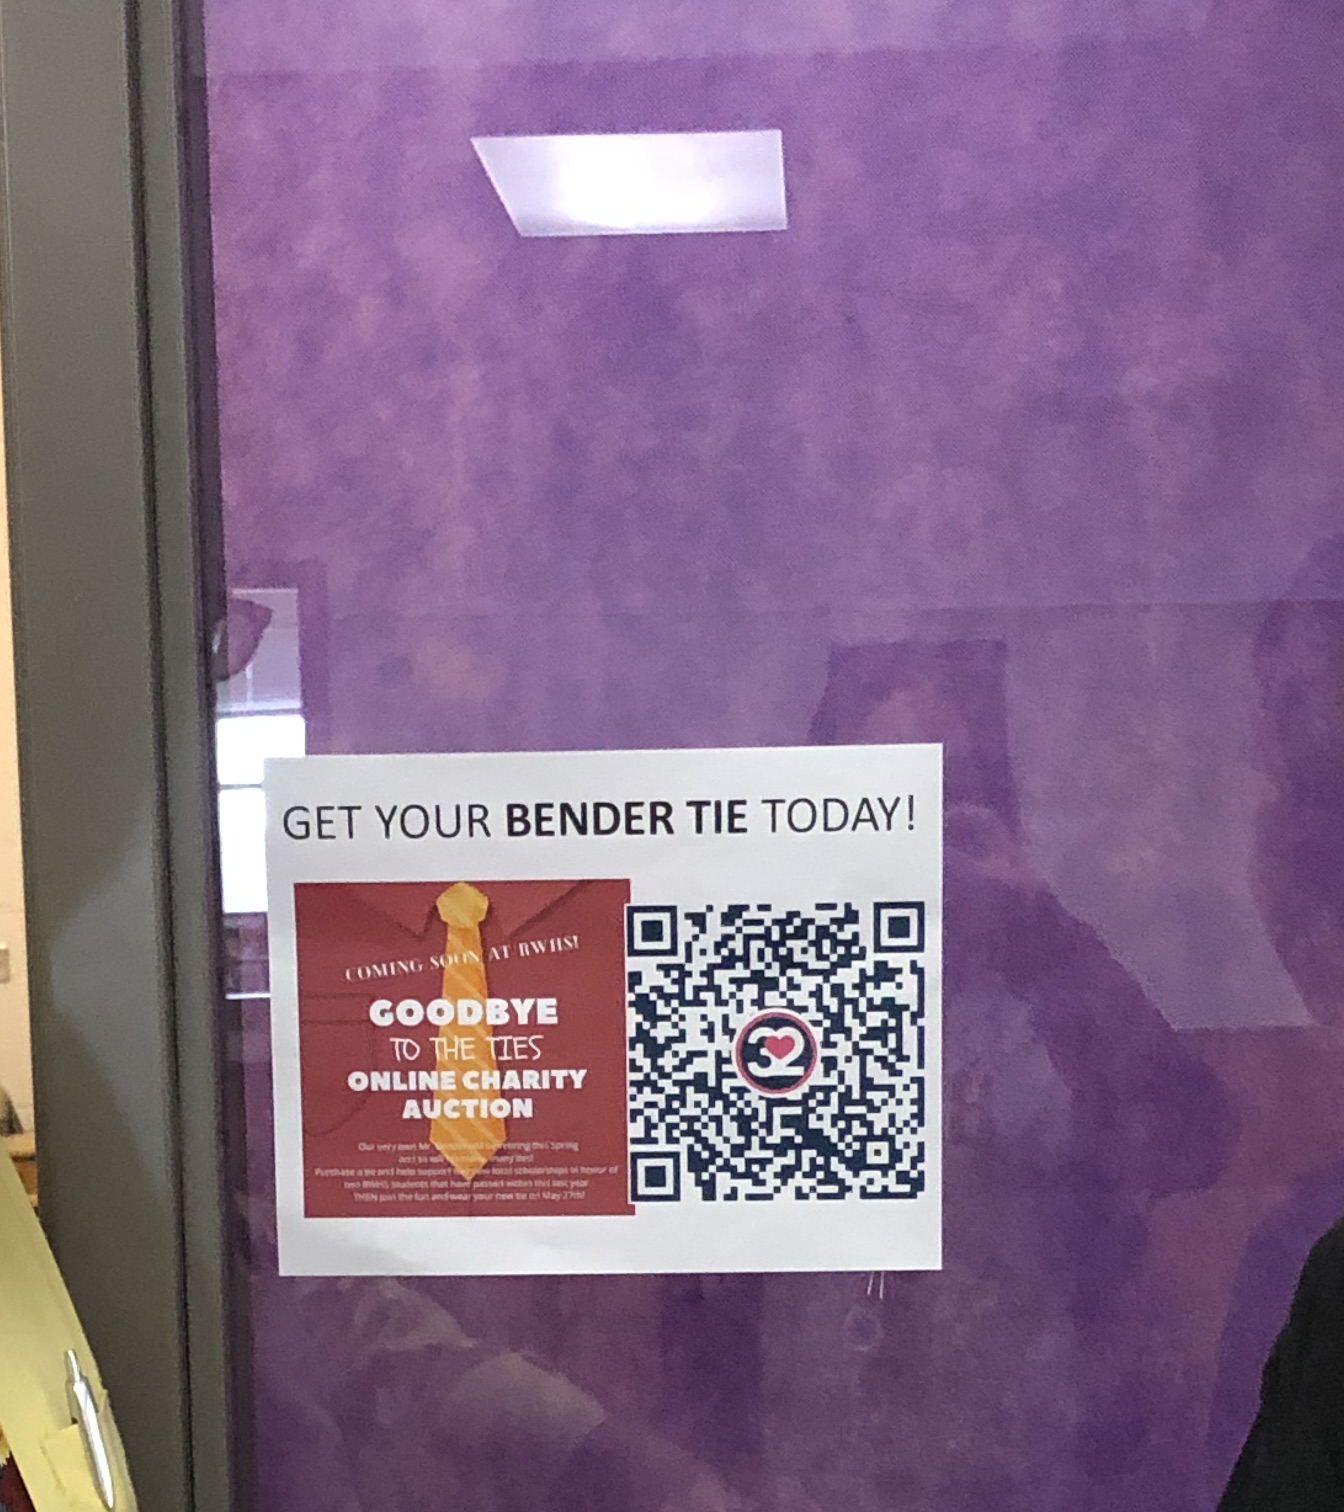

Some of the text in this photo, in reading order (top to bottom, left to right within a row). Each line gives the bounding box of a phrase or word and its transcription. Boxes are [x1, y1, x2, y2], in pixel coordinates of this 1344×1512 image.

[283, 794, 915, 840] GET YOUR BENDER TIE TODAY!
[345, 958, 424, 982] COMING
[429, 950, 481, 971] SOON
[488, 944, 513, 963] AT
[368, 998, 559, 1027] GOODBYE
[389, 1034, 545, 1062] TO THE TIES
[347, 1068, 588, 1092] ONLINE CHARITY
[401, 1097, 534, 1120] AUCTION
